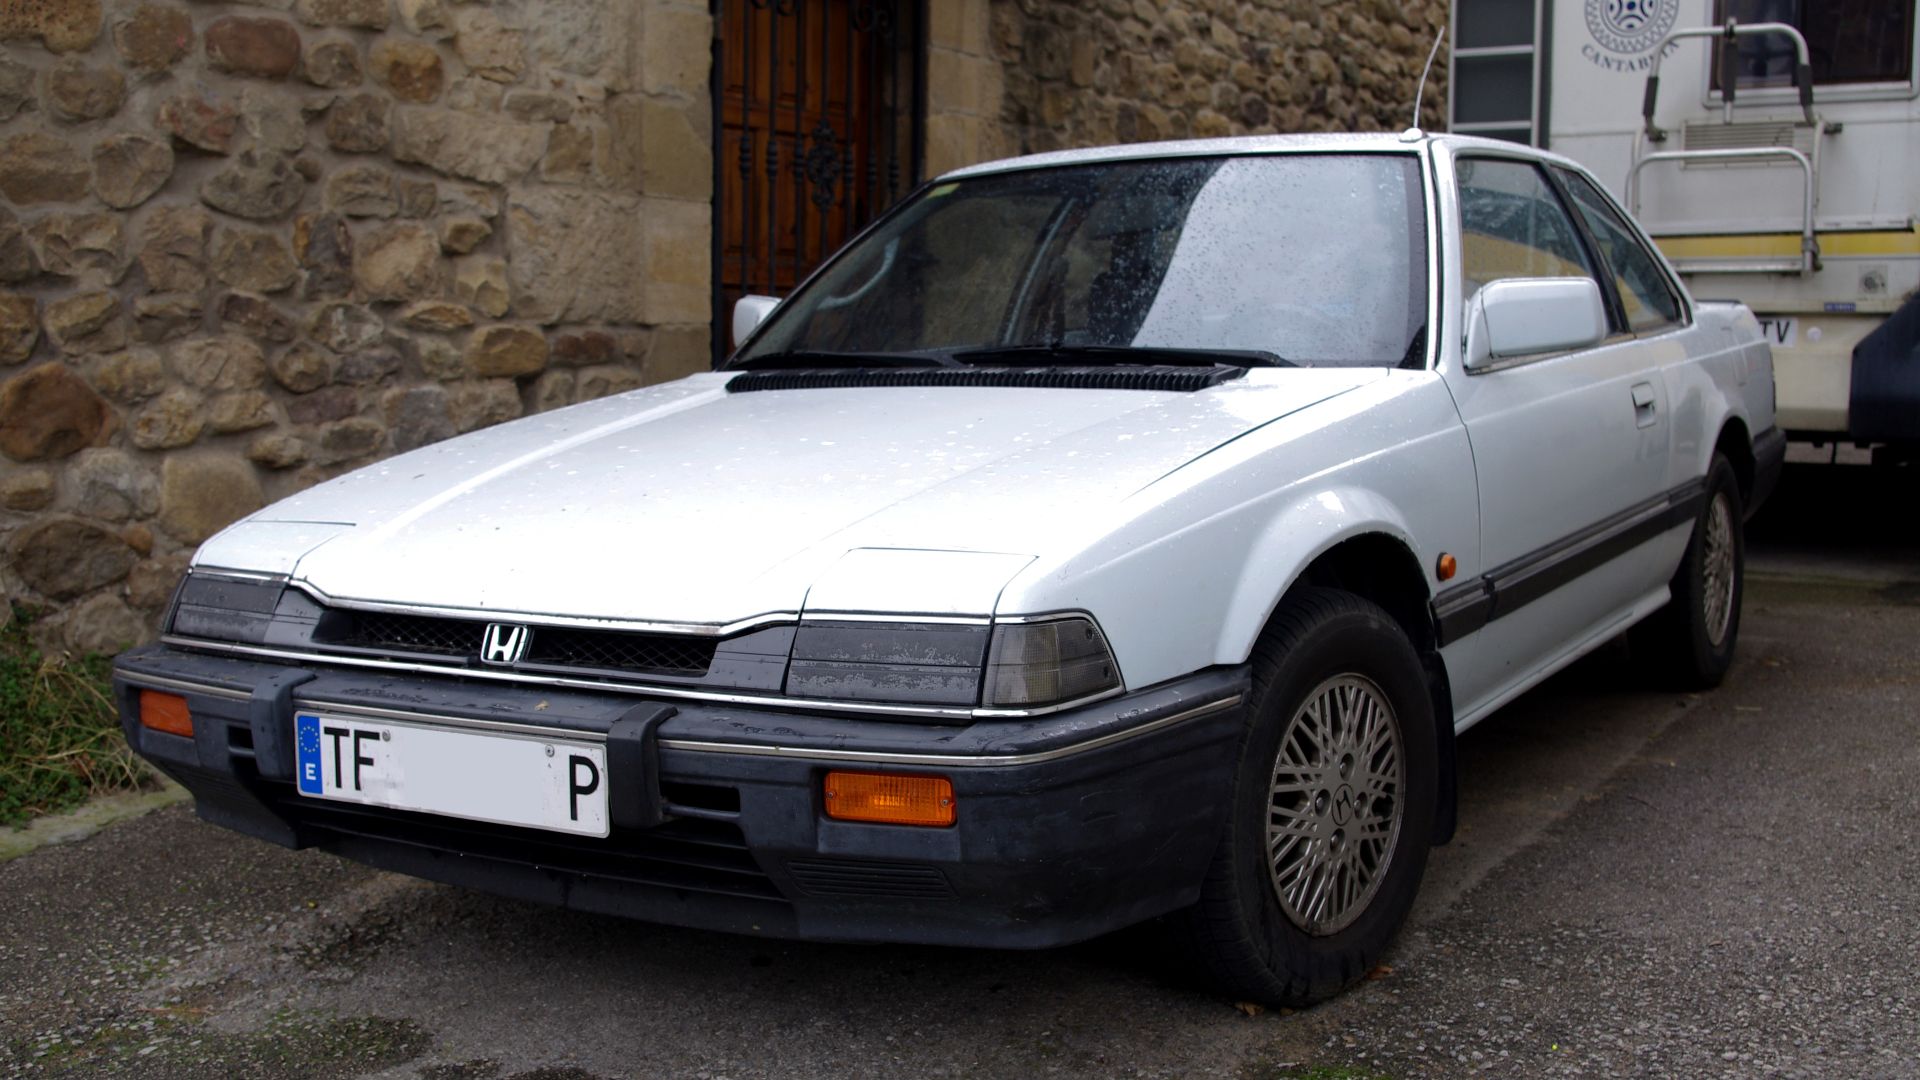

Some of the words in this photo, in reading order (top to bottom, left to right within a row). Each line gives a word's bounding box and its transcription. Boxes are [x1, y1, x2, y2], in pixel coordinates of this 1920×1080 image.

[1758, 319, 1790, 343] TV
[485, 622, 512, 662] H
[305, 763, 316, 781] E
[324, 726, 380, 791] TF
[569, 754, 600, 821] P
